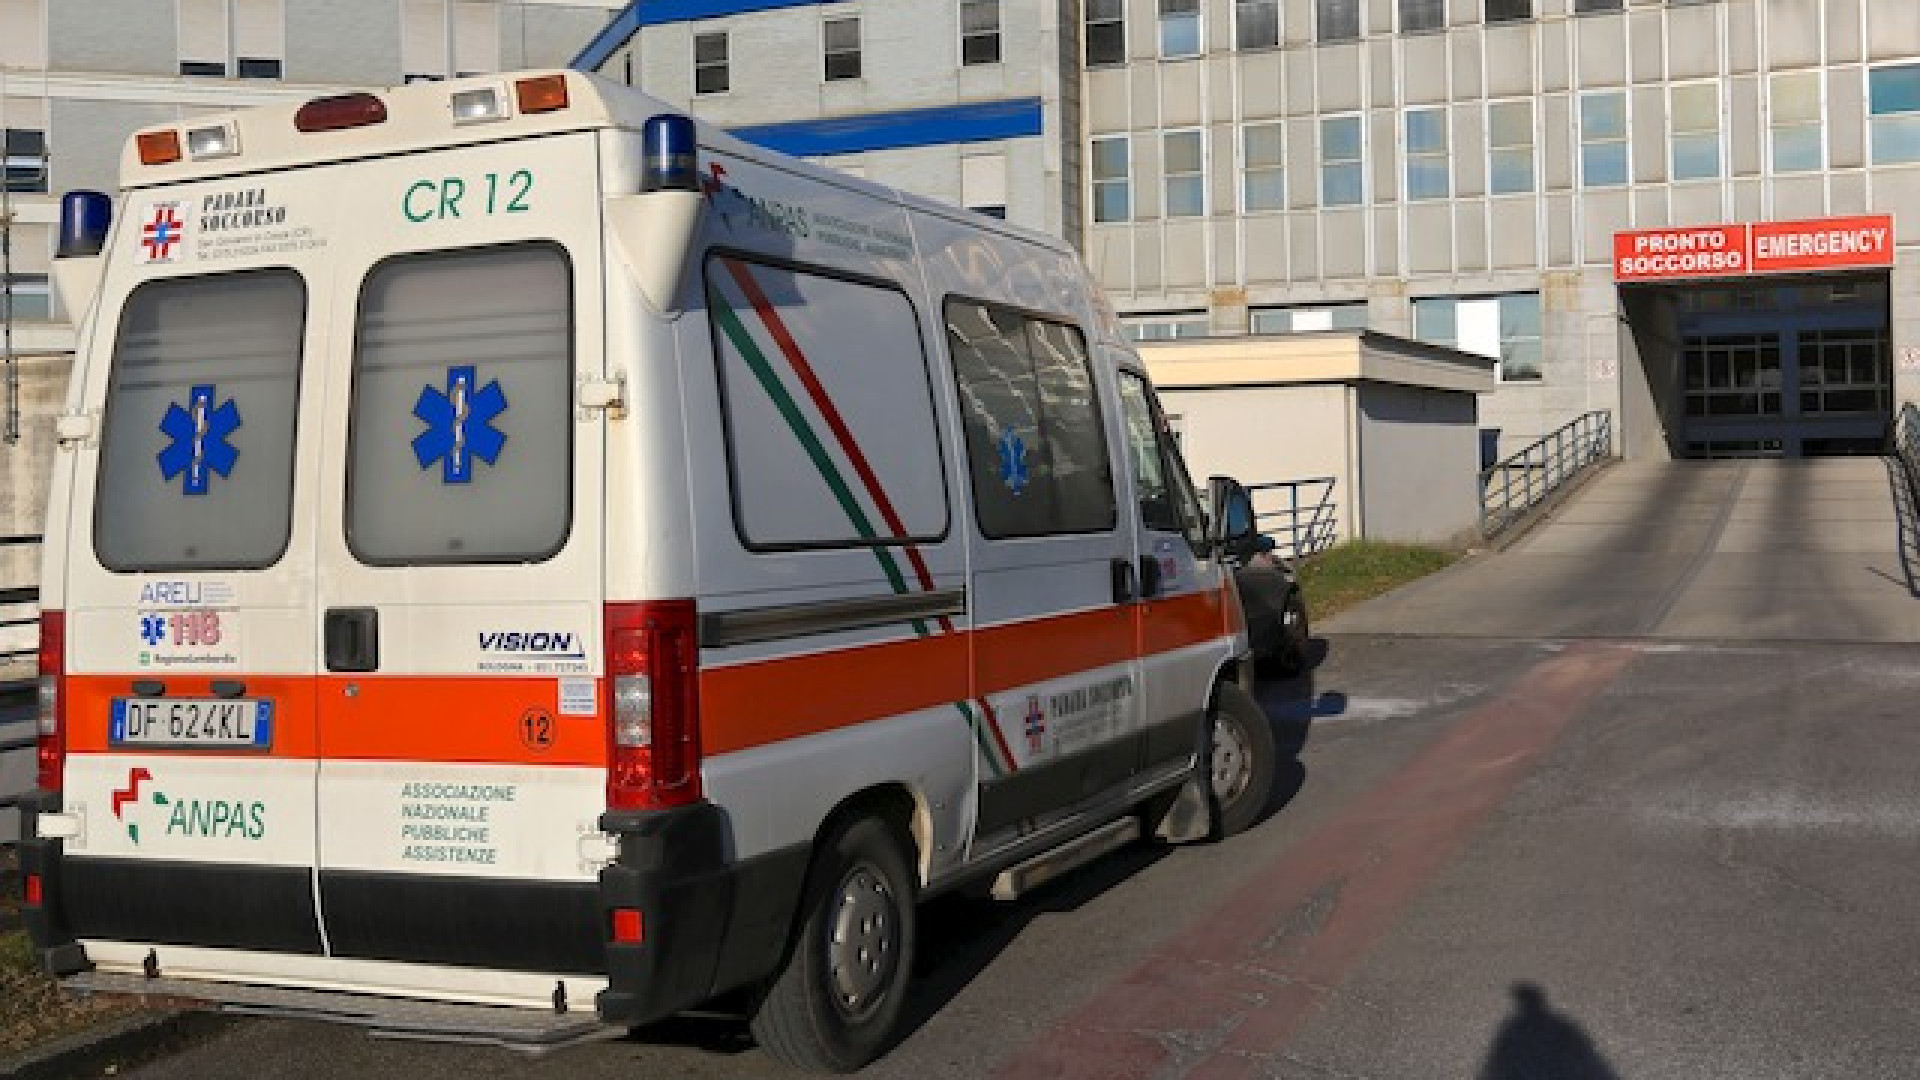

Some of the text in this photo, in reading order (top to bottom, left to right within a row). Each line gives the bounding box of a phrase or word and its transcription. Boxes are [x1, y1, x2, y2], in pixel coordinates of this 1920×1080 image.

[402, 170, 533, 223] CR 12
[1634, 232, 1726, 253] PRONTO
[1756, 227, 1887, 259] EMERGENCY
[1619, 250, 1742, 274] SOCCORSO
[168, 609, 222, 646] 118
[479, 632, 571, 652] VISION
[129, 704, 250, 739] DF 624KL
[524, 716, 550, 745] 12
[401, 782, 517, 802] ASSOCIAZIONE
[165, 798, 266, 841] ANPAS
[401, 803, 490, 822] NAZIONALE
[401, 824, 490, 844] PUBBLICHE
[401, 845, 497, 865] ASSISTENZE
